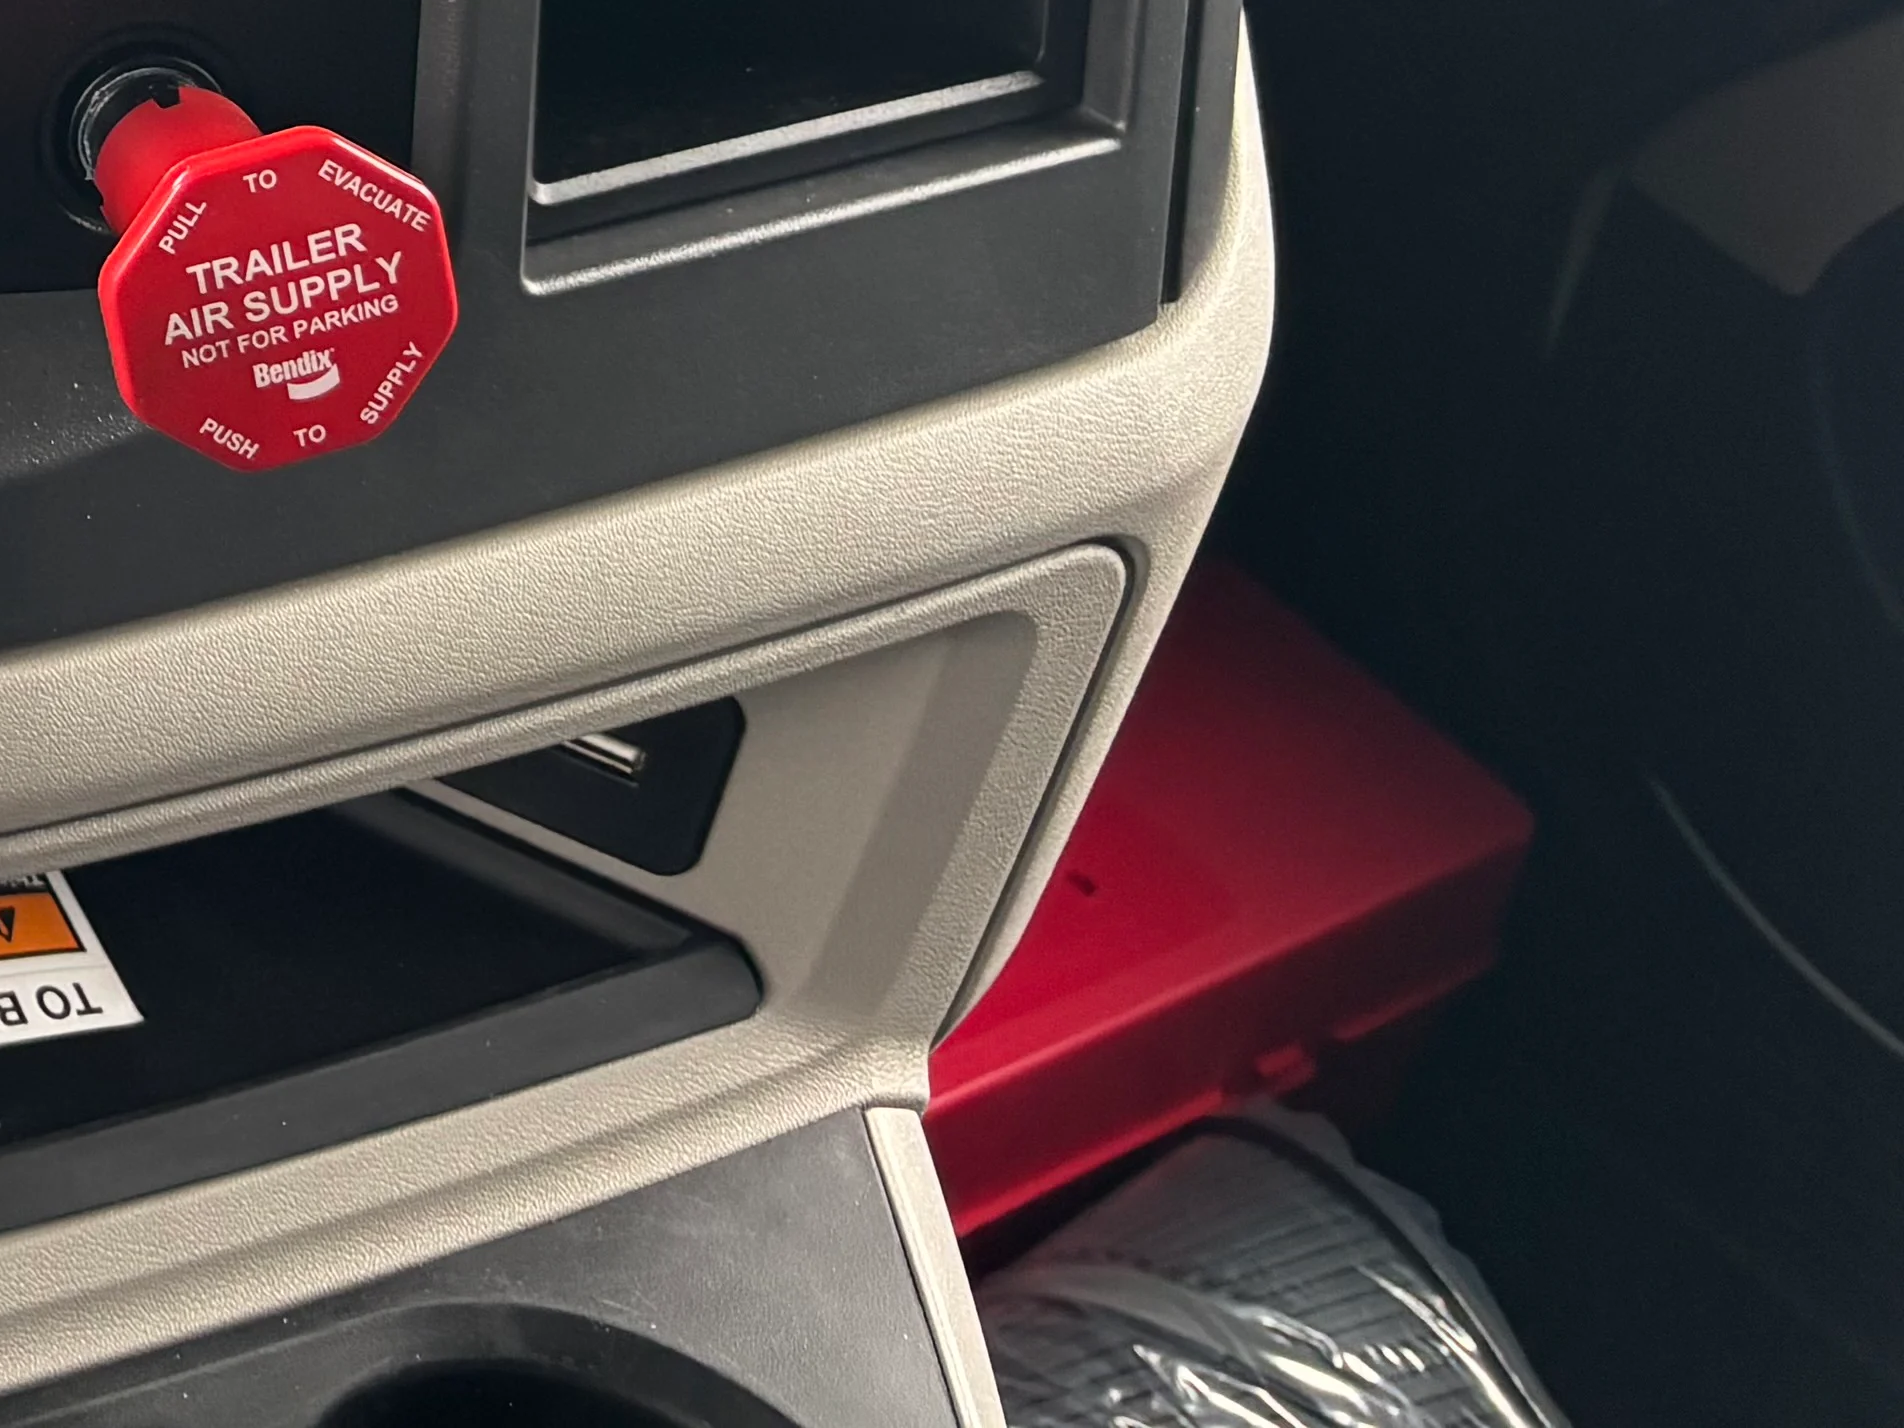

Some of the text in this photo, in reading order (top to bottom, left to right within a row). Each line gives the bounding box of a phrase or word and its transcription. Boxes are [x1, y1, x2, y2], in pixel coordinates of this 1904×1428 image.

[159, 160, 431, 255] PULL TO EVACUATE
[186, 223, 367, 295] TRAILER
[165, 251, 403, 346] AIR SUPPLY
[182, 294, 399, 369] NOT FOR PARKING
[199, 341, 425, 460] PUSH TO SUPPLY
[253, 350, 332, 389] Bendix
[35, 982, 104, 1021] TO
